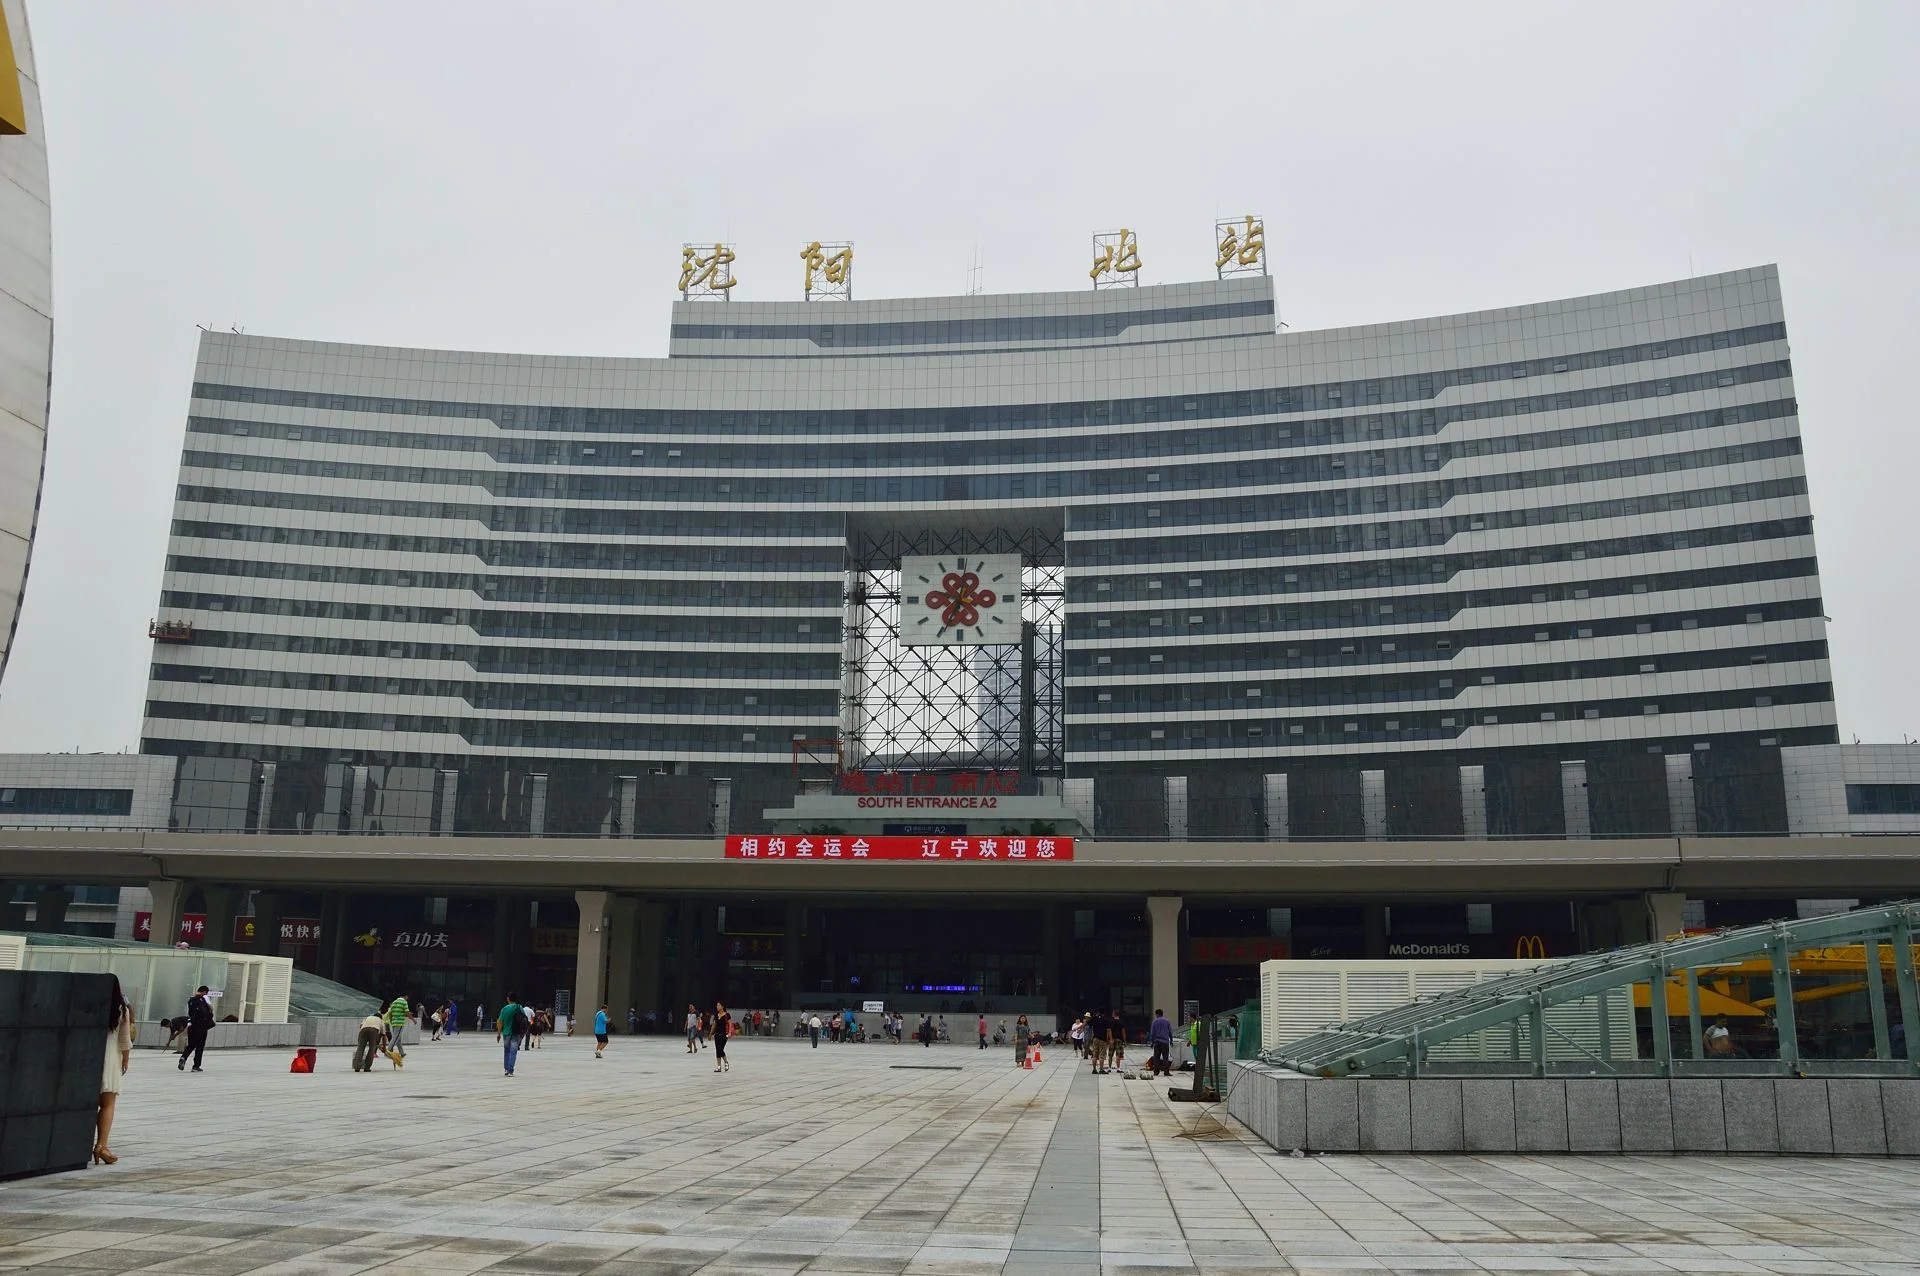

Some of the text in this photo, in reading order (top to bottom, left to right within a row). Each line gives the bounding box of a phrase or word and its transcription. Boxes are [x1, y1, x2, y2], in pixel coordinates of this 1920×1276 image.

[858, 796, 998, 809] SOUTH ENTRANCE A2
[934, 825, 946, 835] A2
[740, 837, 1056, 859] 相约全运会 辽宁欢迎您
[393, 931, 449, 948] 真功夫
[1389, 943, 1470, 956] McDonald's
